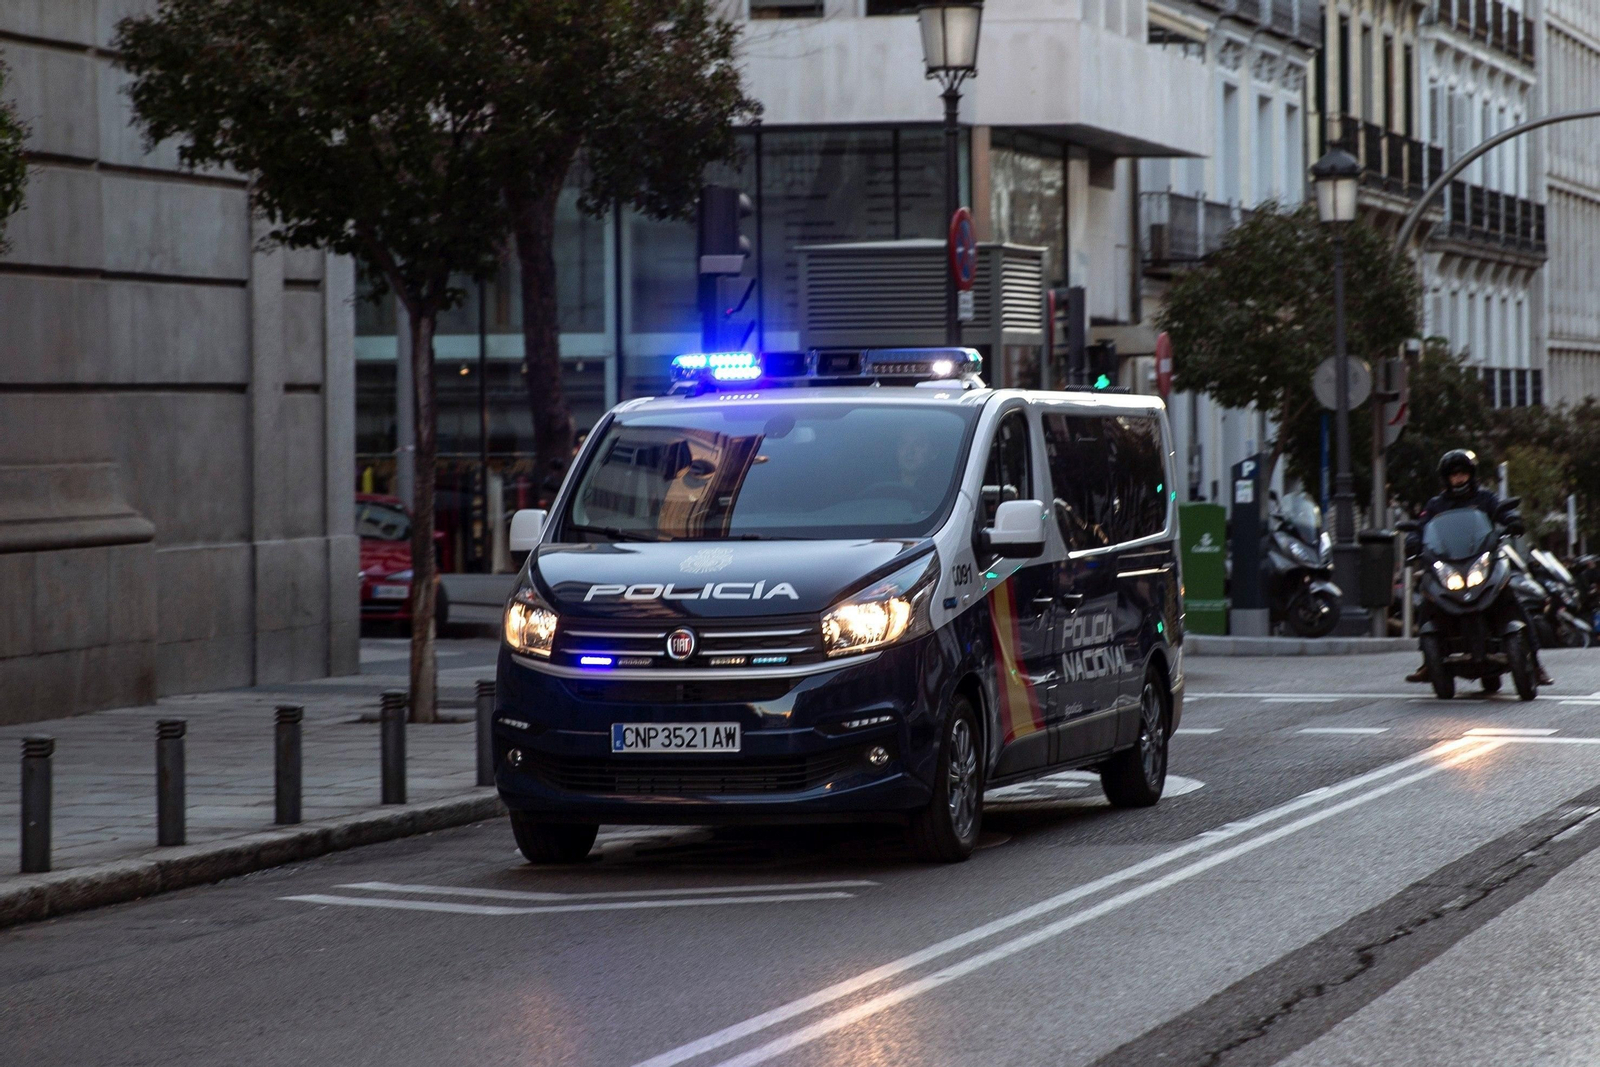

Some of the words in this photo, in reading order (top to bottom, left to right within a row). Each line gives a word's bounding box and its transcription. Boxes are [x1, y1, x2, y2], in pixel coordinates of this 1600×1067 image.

[1241, 460, 1257, 478] P
[582, 579, 800, 602] POLICÍA
[673, 637, 690, 652] FIAT
